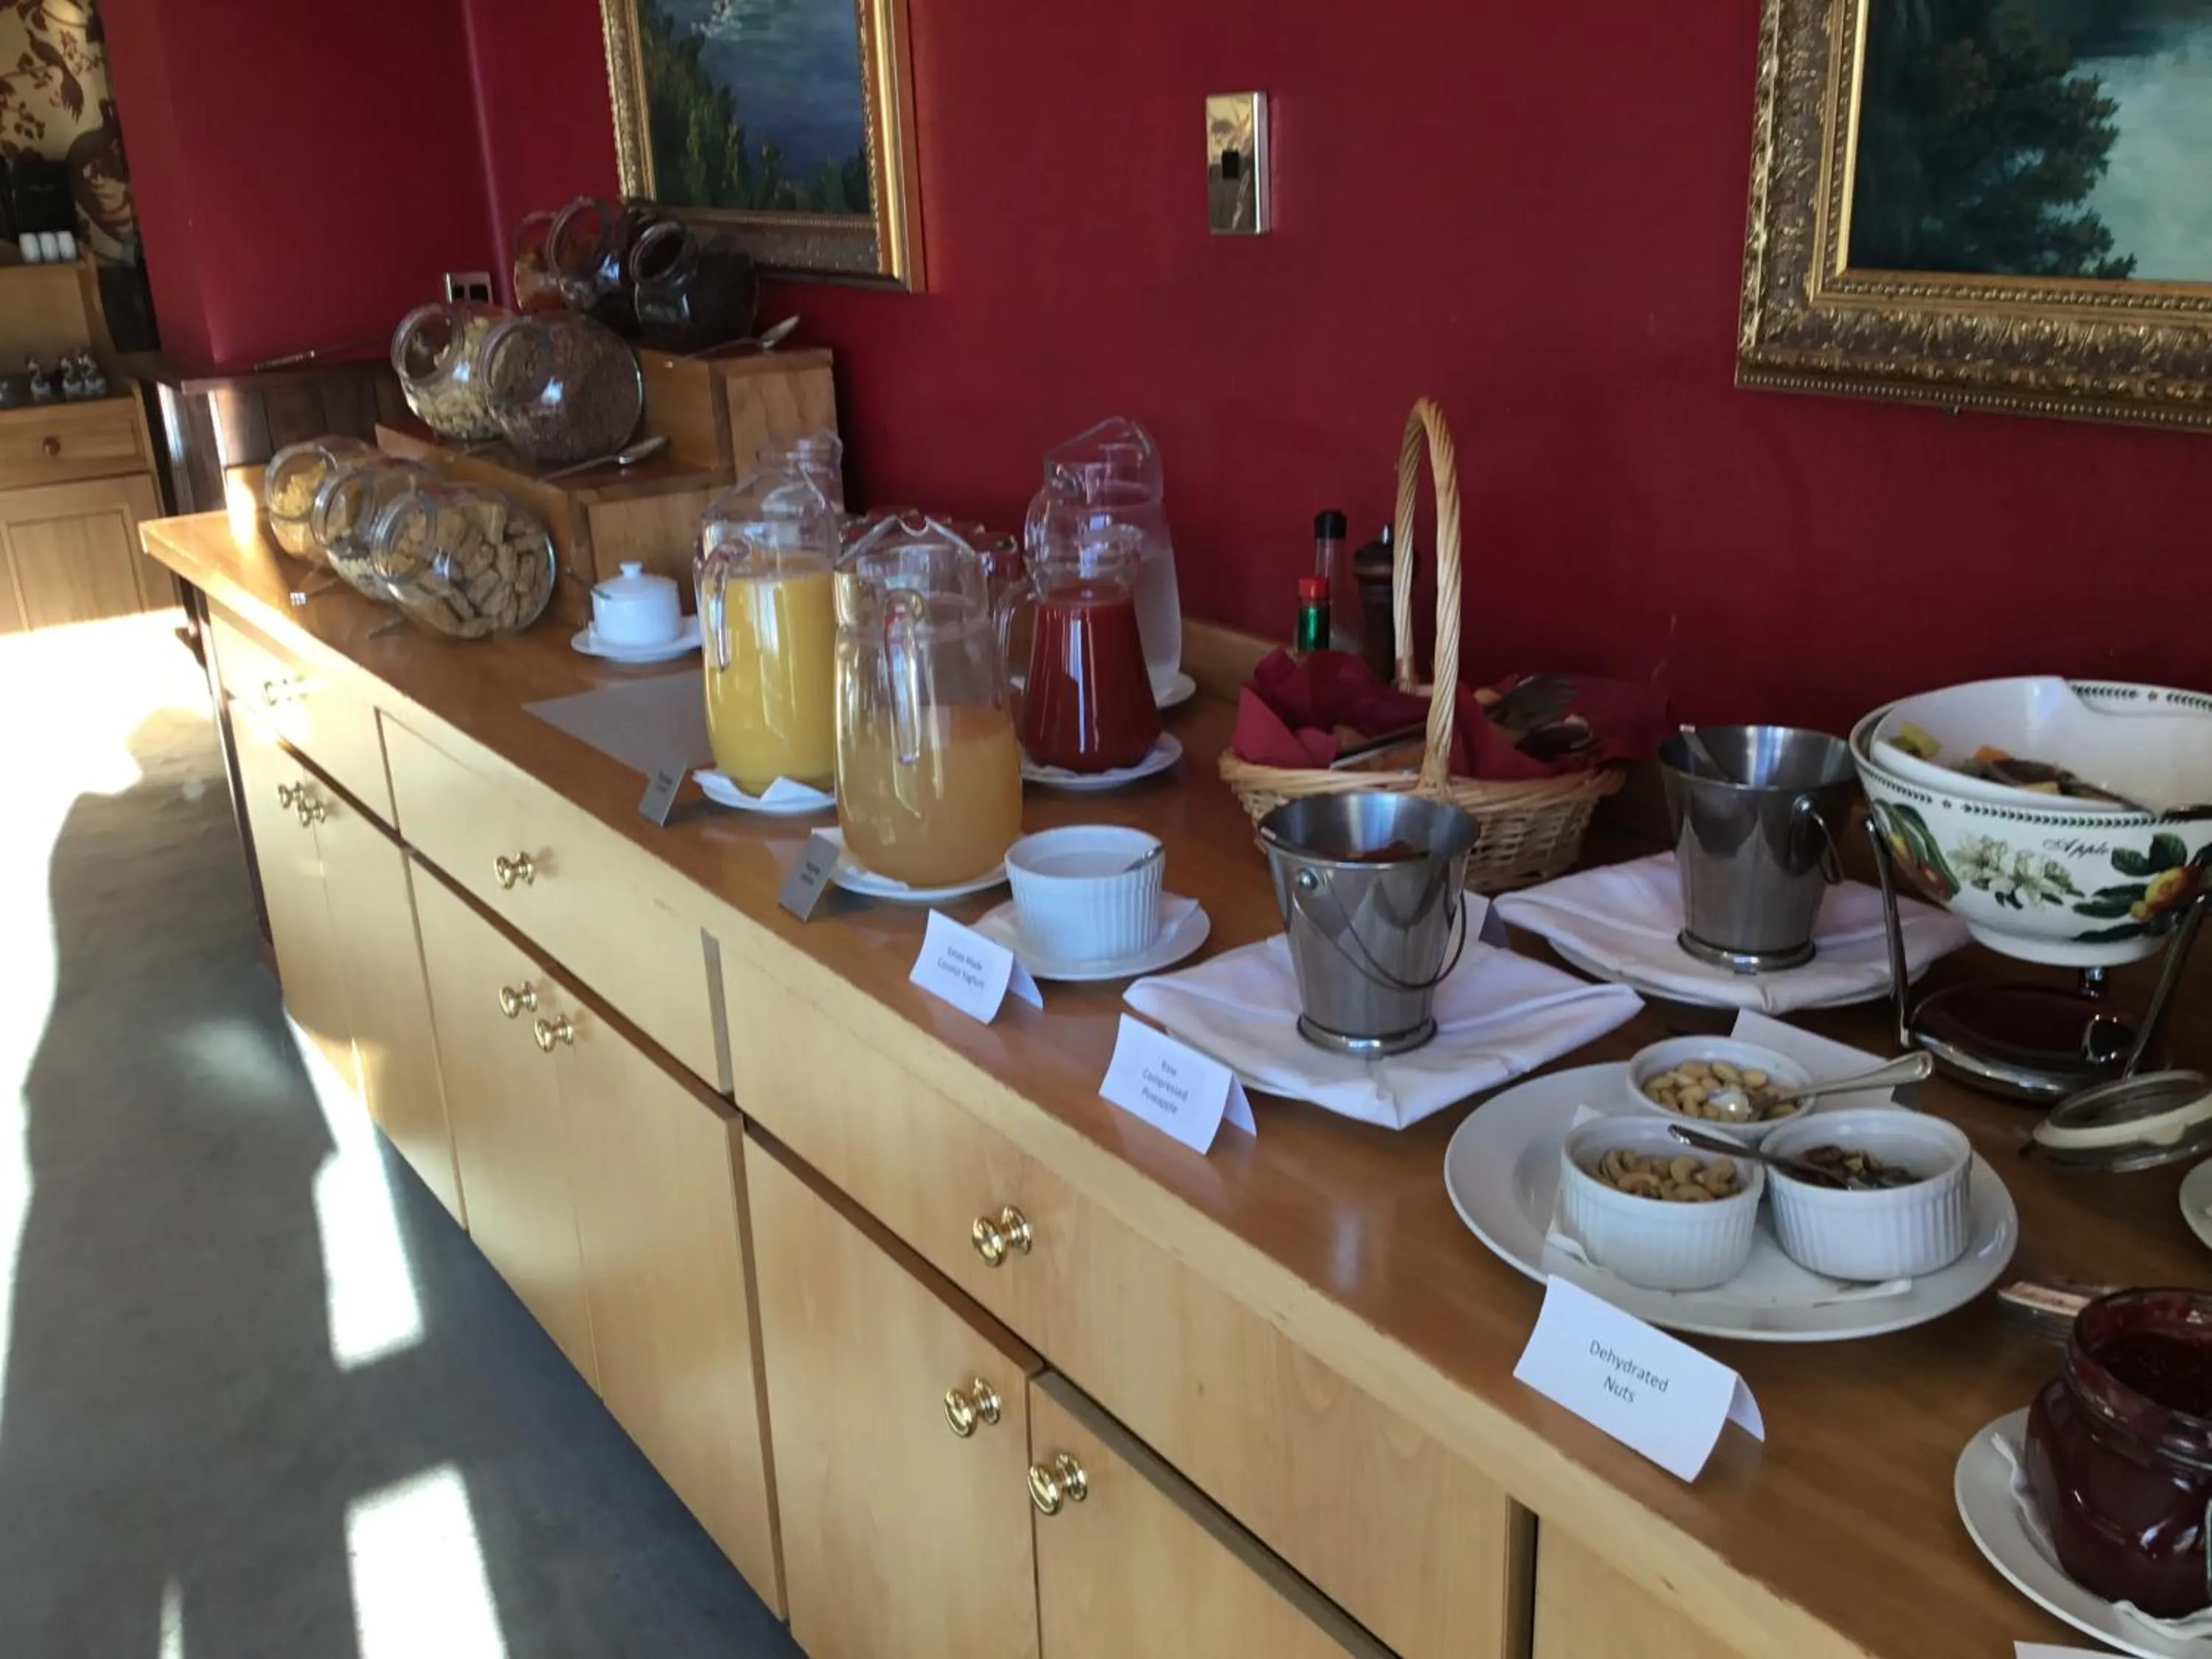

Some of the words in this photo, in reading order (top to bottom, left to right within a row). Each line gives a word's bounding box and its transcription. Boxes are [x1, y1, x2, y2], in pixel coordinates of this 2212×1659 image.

[2041, 836, 2110, 860] Apple
[1141, 1068, 1188, 1101] Compressed
[1588, 1339, 1669, 1393] Dehydrated
[1603, 1375, 1636, 1404] Nuts
